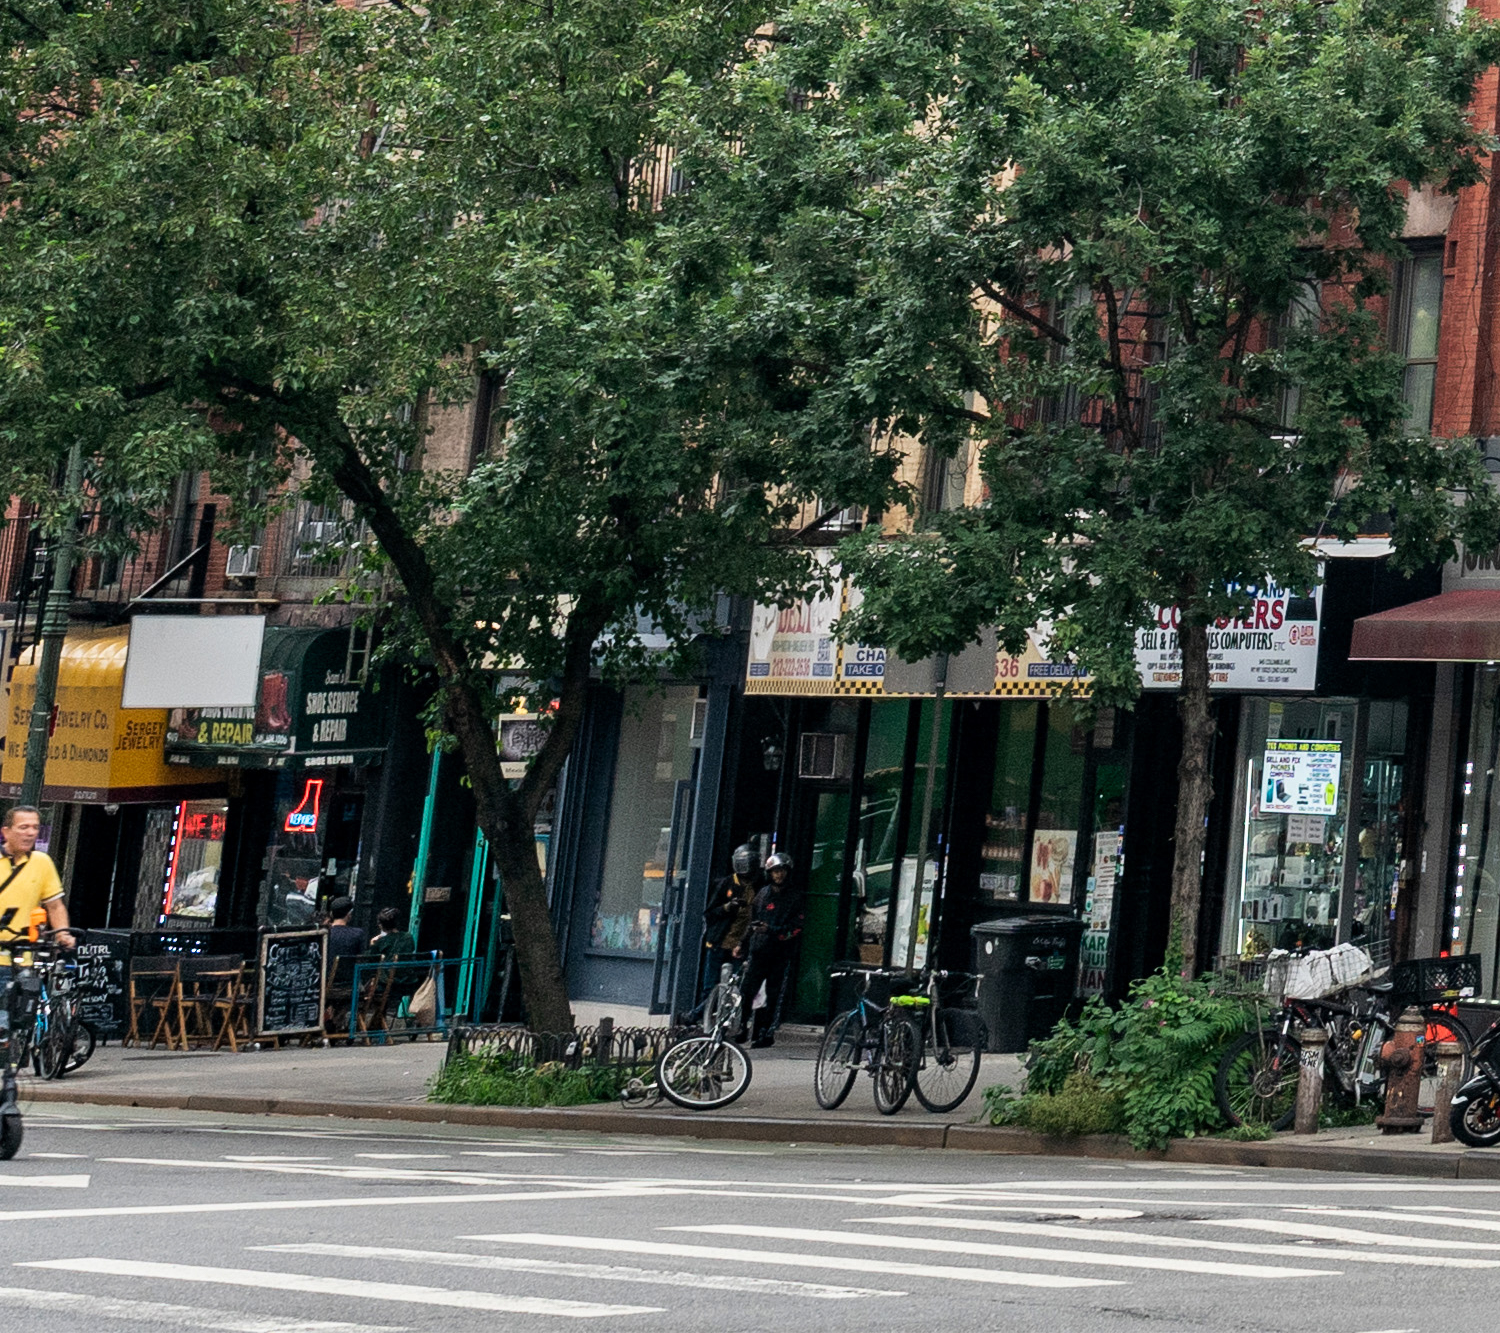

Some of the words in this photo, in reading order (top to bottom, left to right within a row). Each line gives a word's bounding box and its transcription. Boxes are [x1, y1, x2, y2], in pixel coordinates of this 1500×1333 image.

[1140, 633, 1157, 650] SELL
[1159, 633, 1166, 650] &
[1220, 632, 1273, 650] COMPUTERS
[846, 664, 873, 677] TAKE
[1029, 665, 1049, 677] FREE
[306, 691, 329, 715] SHOE
[330, 690, 359, 713] SERVICE
[198, 723, 208, 744] &
[212, 722, 253, 744] REPAIR
[312, 725, 319, 742] &
[320, 719, 348, 742] REPAIR
[115, 735, 160, 751] JEWELRY
[305, 757, 325, 766] SHOE
[327, 756, 354, 765] REPAIR
